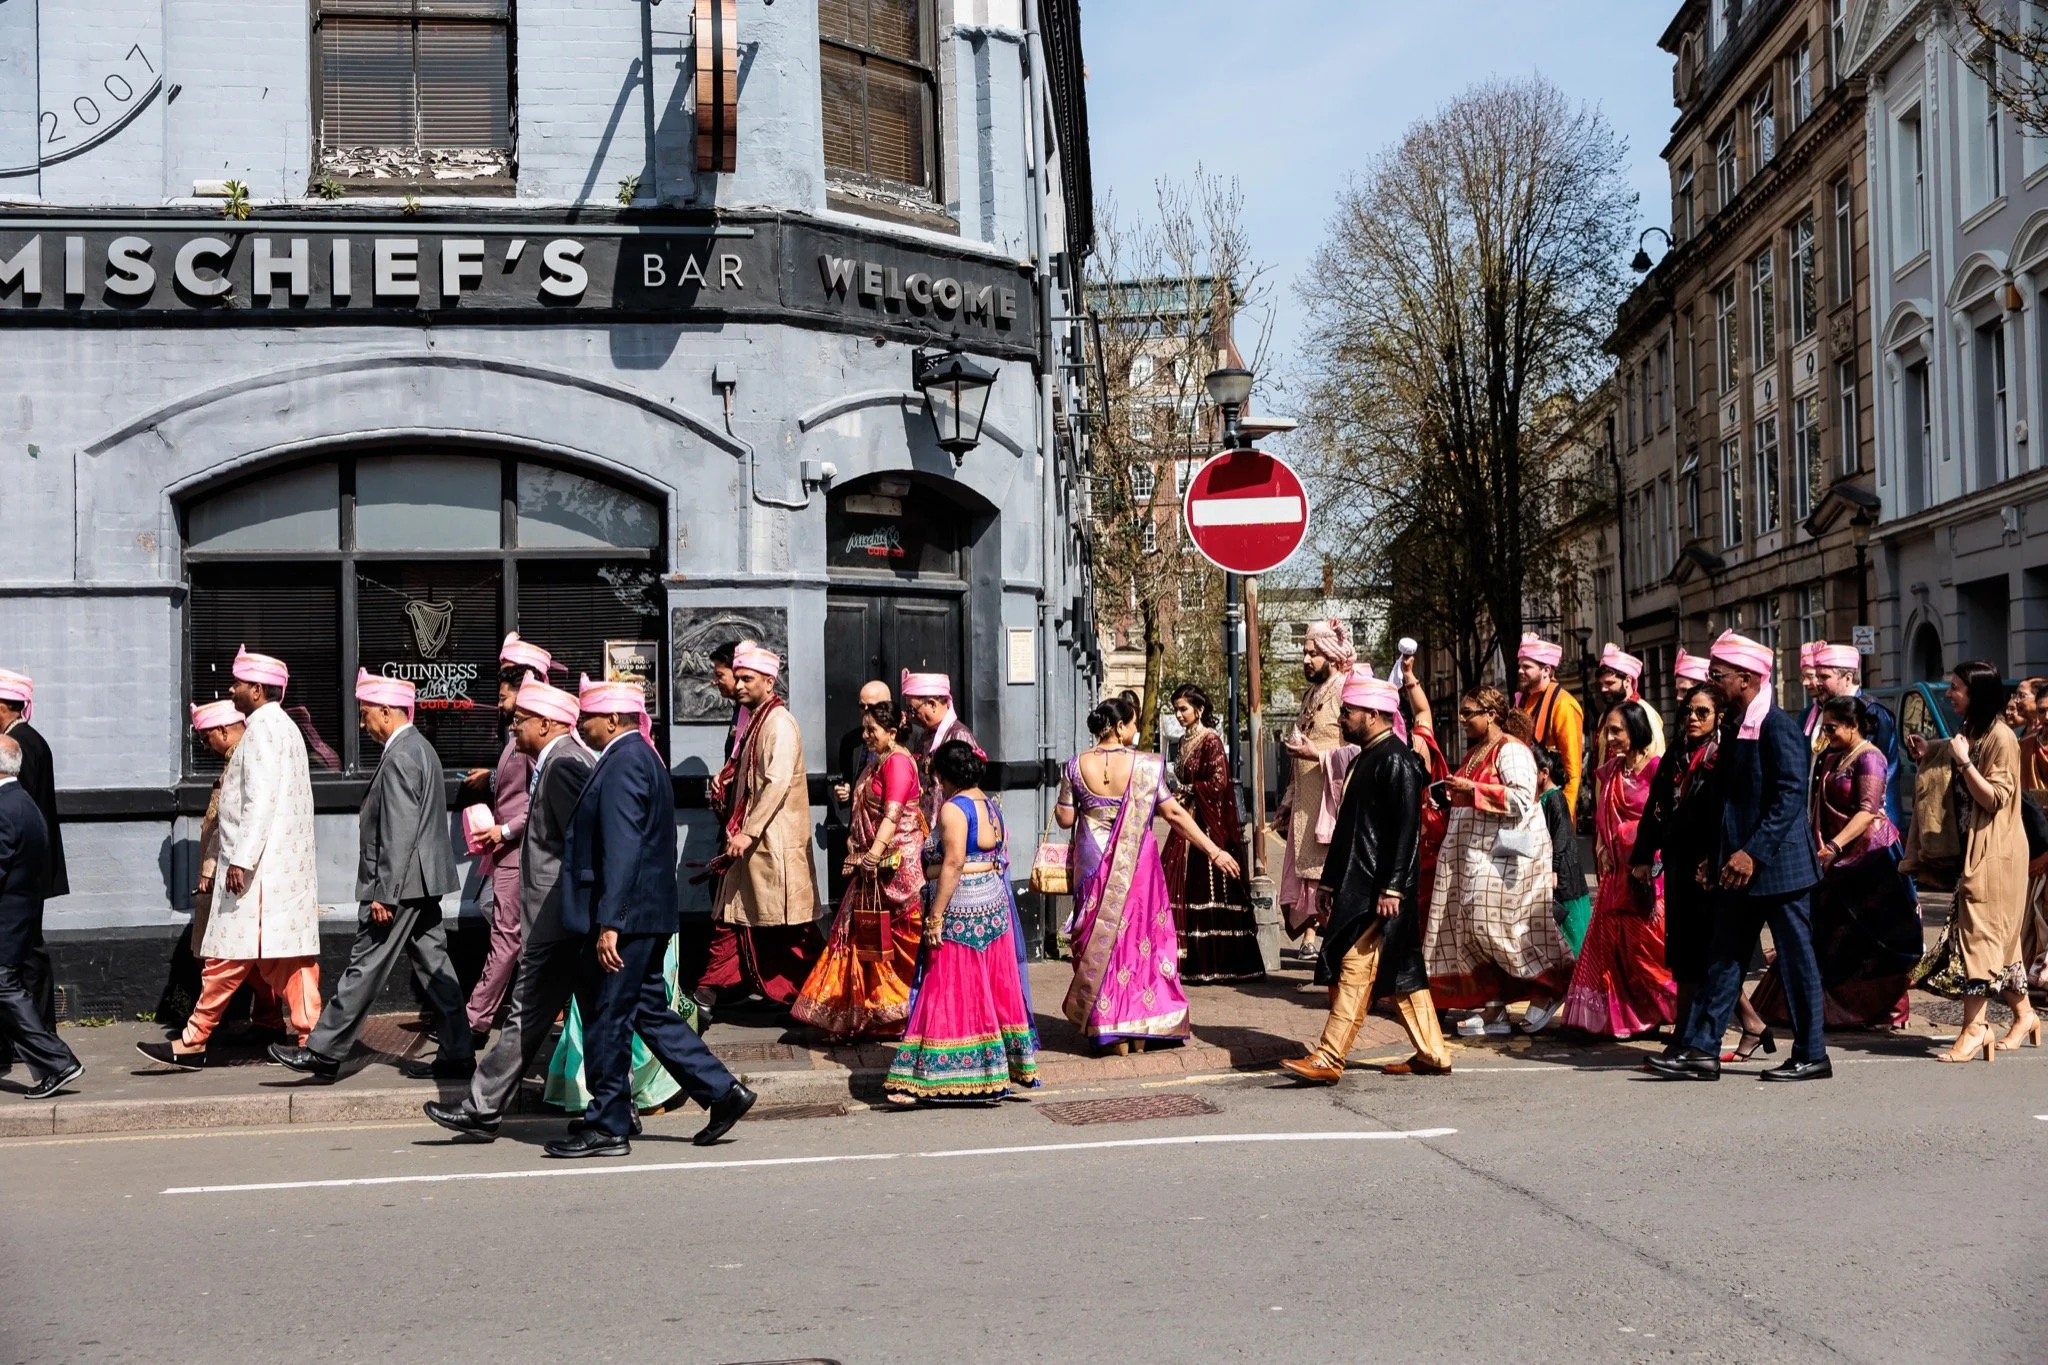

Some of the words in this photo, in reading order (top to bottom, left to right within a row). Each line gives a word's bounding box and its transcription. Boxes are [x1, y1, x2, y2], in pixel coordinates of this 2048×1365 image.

[40, 43, 154, 143] 2007
[0, 233, 589, 297] MISCHIEF'S
[643, 253, 744, 288] BAR
[818, 254, 1017, 320] WELCOME
[382, 661, 478, 680] GUINNESS
[415, 674, 472, 702] schief's
